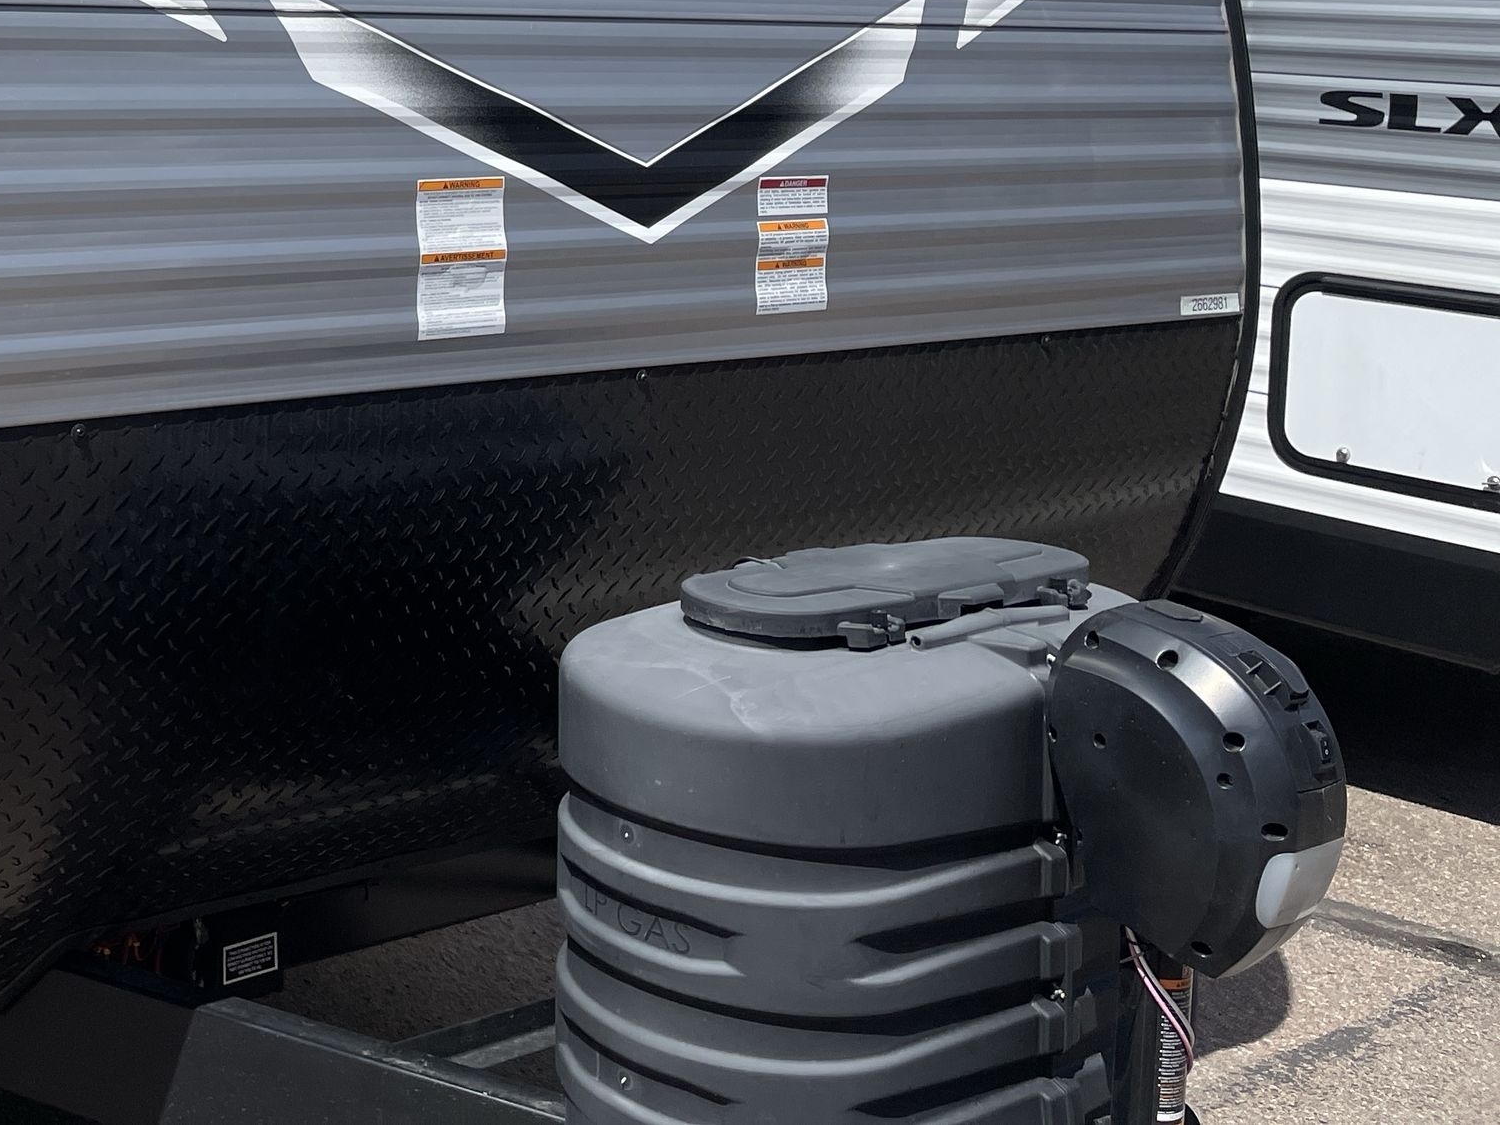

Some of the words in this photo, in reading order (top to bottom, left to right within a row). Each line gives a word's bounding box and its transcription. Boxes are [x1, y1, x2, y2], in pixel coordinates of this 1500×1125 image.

[1318, 90, 1500, 138] SLX
[448, 180, 481, 189] WARNING
[784, 179, 808, 187] DANGER
[1192, 296, 1228, 312] 2662981
[617, 903, 690, 954] GAS
